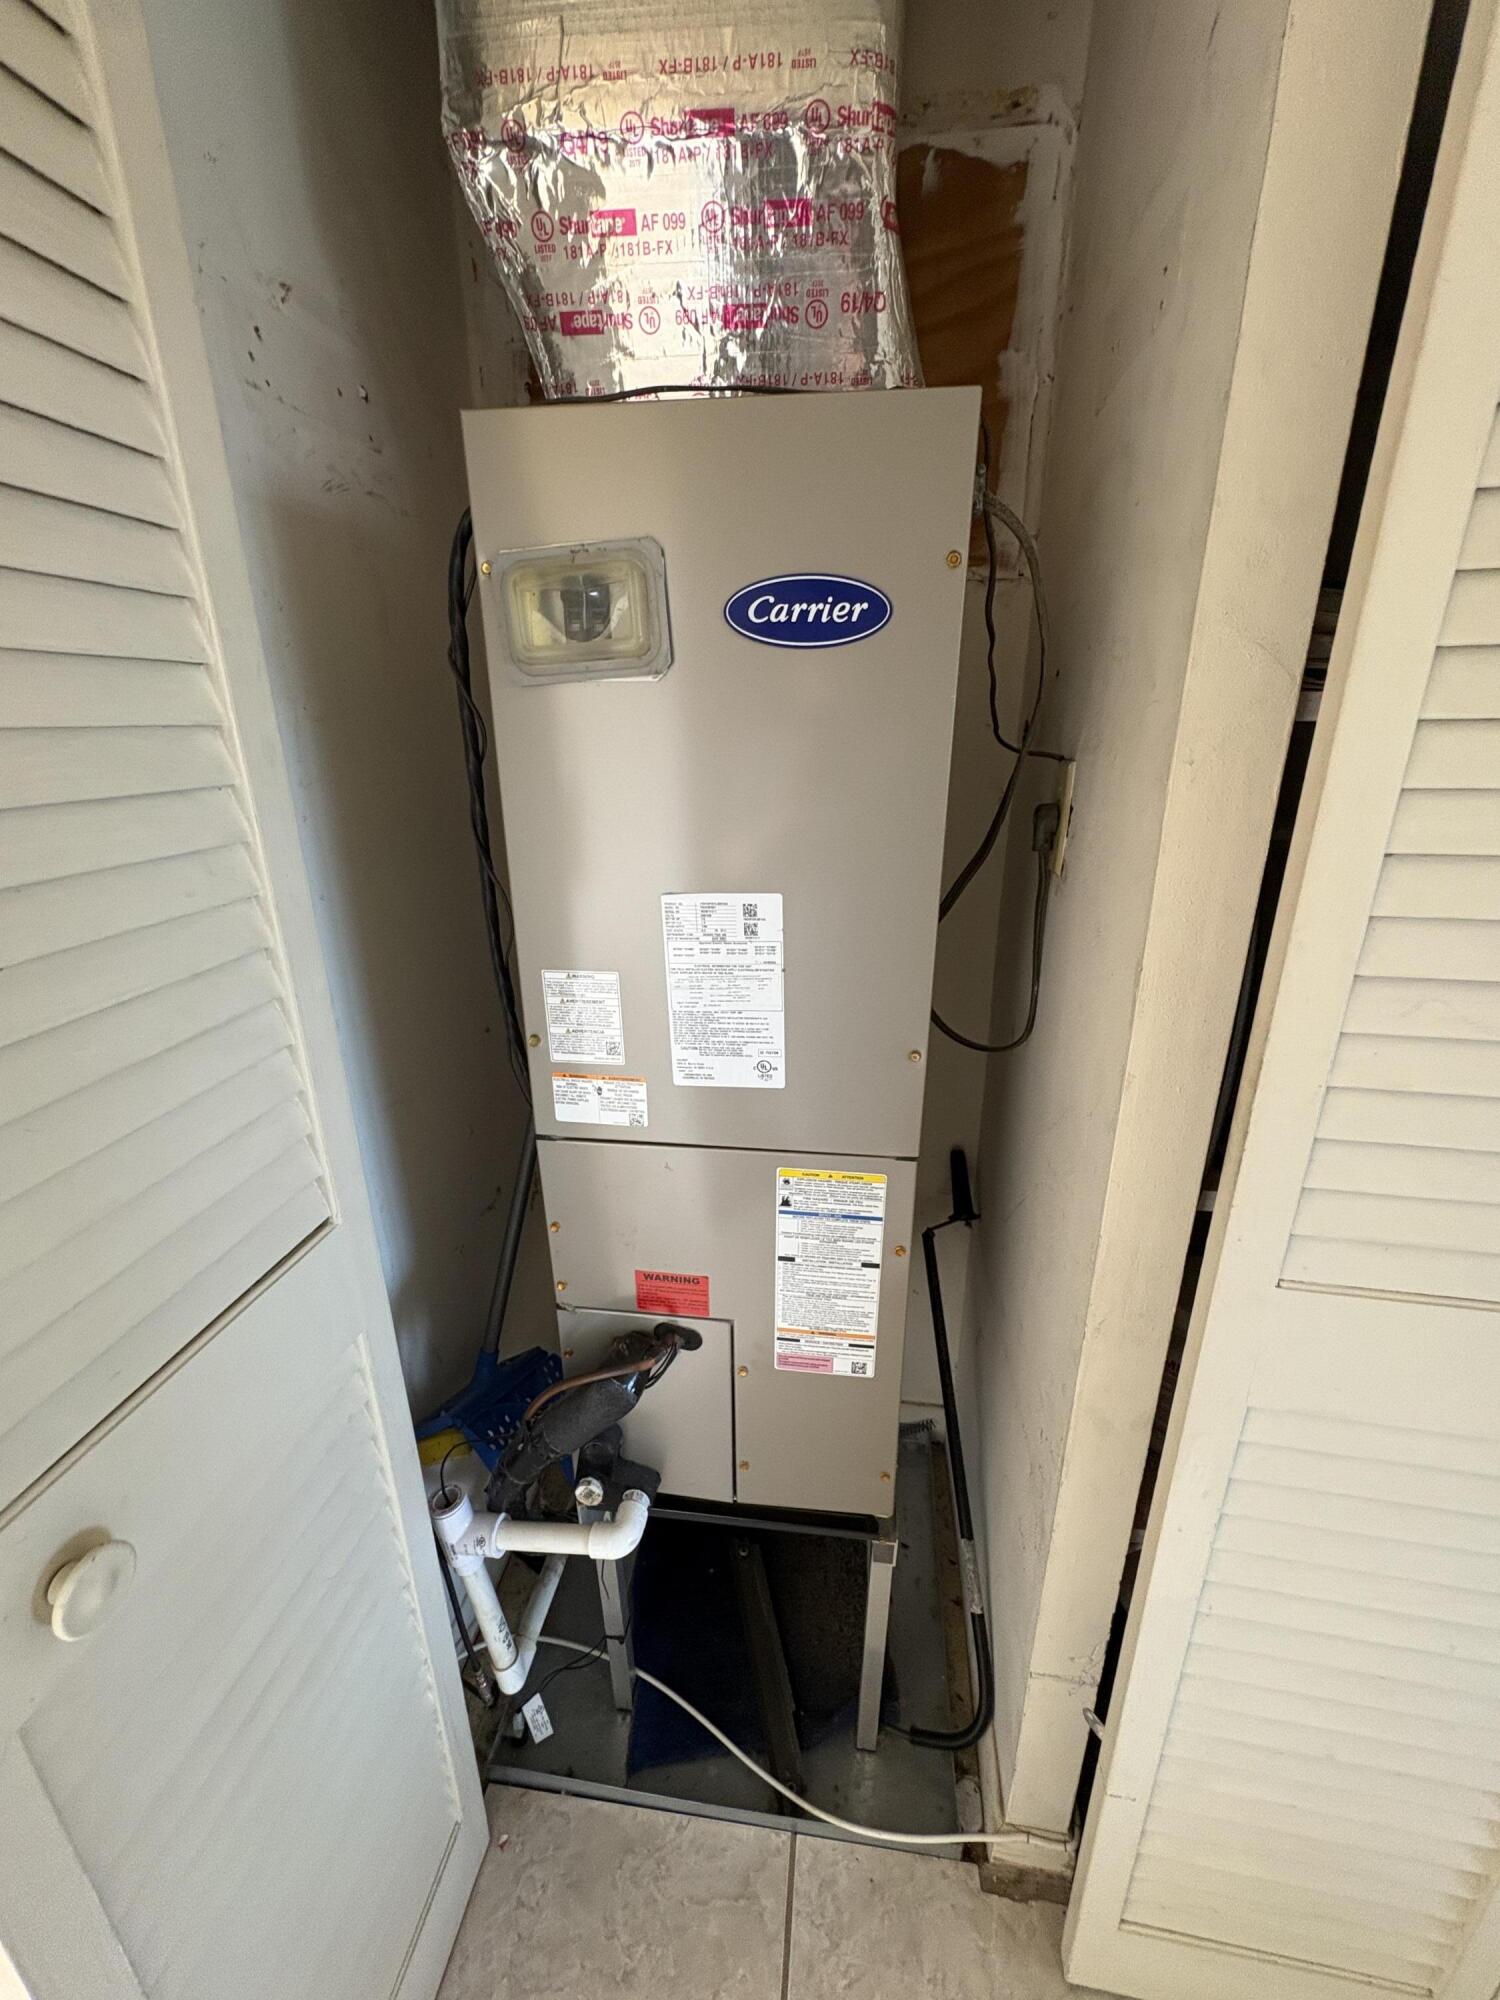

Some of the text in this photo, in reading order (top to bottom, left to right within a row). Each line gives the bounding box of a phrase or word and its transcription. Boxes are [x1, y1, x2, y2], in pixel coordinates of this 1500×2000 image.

[659, 55, 718, 74] 181B-FX
[733, 52, 784, 71] 181A-P
[791, 58, 817, 69] LISTED
[547, 63, 594, 82] 181A-P
[641, 213, 660, 231] AF
[662, 212, 686, 230] 099
[816, 204, 835, 222] AF
[840, 202, 865, 221] 099
[534, 243, 556, 255] LISTED
[563, 244, 607, 261] 181A-P
[619, 239, 673, 258] 181B-FX
[805, 287, 829, 298] LISTED
[841, 291, 887, 313] Q4/19
[801, 372, 844, 386] 181A-P
[748, 595, 869, 624] Carrier
[643, 1272, 700, 1285] WARNING
